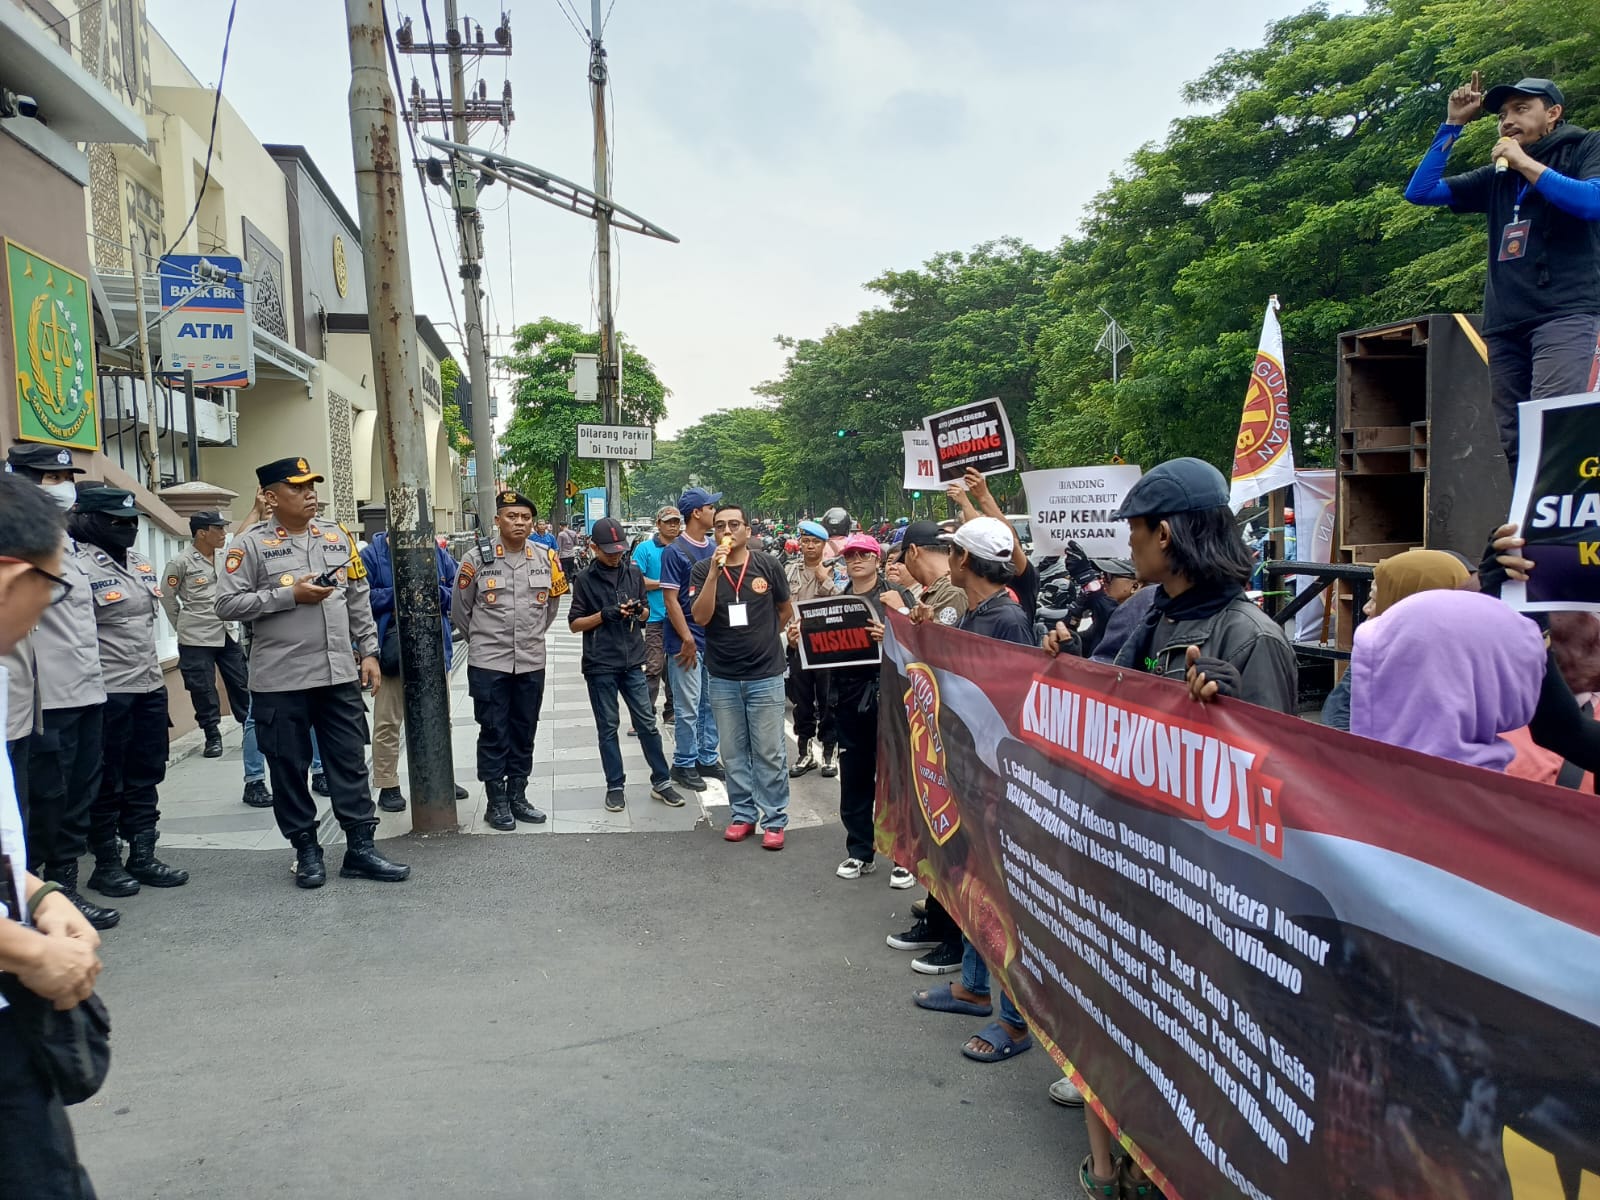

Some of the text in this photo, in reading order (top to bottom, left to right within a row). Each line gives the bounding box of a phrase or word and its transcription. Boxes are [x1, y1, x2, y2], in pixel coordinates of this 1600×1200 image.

[170, 286, 211, 298] BANK
[177, 323, 233, 340] ATM
[580, 428, 648, 441] Dilarang Parkir
[938, 420, 998, 448] CABUT
[592, 445, 638, 454] Di Trotoar
[940, 434, 1002, 460] BANDING
[918, 460, 934, 476] MI
[1580, 457, 1600, 478] G
[1038, 510, 1066, 524] SIAP
[1050, 528, 1116, 540] KEJAKSAAN
[262, 548, 293, 558] YANUAR
[828, 605, 843, 615] ASET
[808, 628, 870, 653] MISKIN
[1022, 680, 1080, 752] KAMI
[1003, 758, 1011, 775] 1.
[1011, 760, 1032, 788] Cabut
[1058, 789, 1080, 820] Kasus
[1080, 804, 1116, 840] Pidana
[1119, 822, 1166, 865] Dengan
[1170, 846, 1208, 891] Nomor
[1210, 872, 1269, 930] Perkara
[1274, 907, 1330, 967] Nomor
[1090, 838, 1115, 870] Atas
[1114, 850, 1147, 888] Nama
[1147, 868, 1205, 926] Terdakwa
[1206, 904, 1232, 952] Putra
[1234, 928, 1302, 994] Wibowo
[1078, 886, 1098, 917] Hak
[1100, 901, 1136, 946] Korban
[1140, 928, 1166, 966] Atas
[1170, 949, 1195, 991] Aset
[1200, 971, 1229, 1022] Yang
[1232, 1000, 1268, 1056] Telah
[1269, 1036, 1315, 1102] Disita
[1058, 898, 1109, 954] Pengadilan
[1112, 938, 1147, 984] Negeri
[1151, 968, 1208, 1036] Surabaya
[1212, 1018, 1261, 1090] Perkara
[1266, 1071, 1315, 1144] Nomor
[1101, 958, 1121, 993] Atas
[1120, 976, 1151, 1020] Nama
[1150, 1000, 1208, 1071] Terdakwa
[1208, 1051, 1238, 1106] Putra
[1238, 1083, 1288, 1165] Wibowo
[1104, 1014, 1133, 1058] Harus
[1134, 1042, 1178, 1112] Membela
[1176, 1093, 1196, 1137] Hak
[1194, 1122, 1216, 1166] dan
